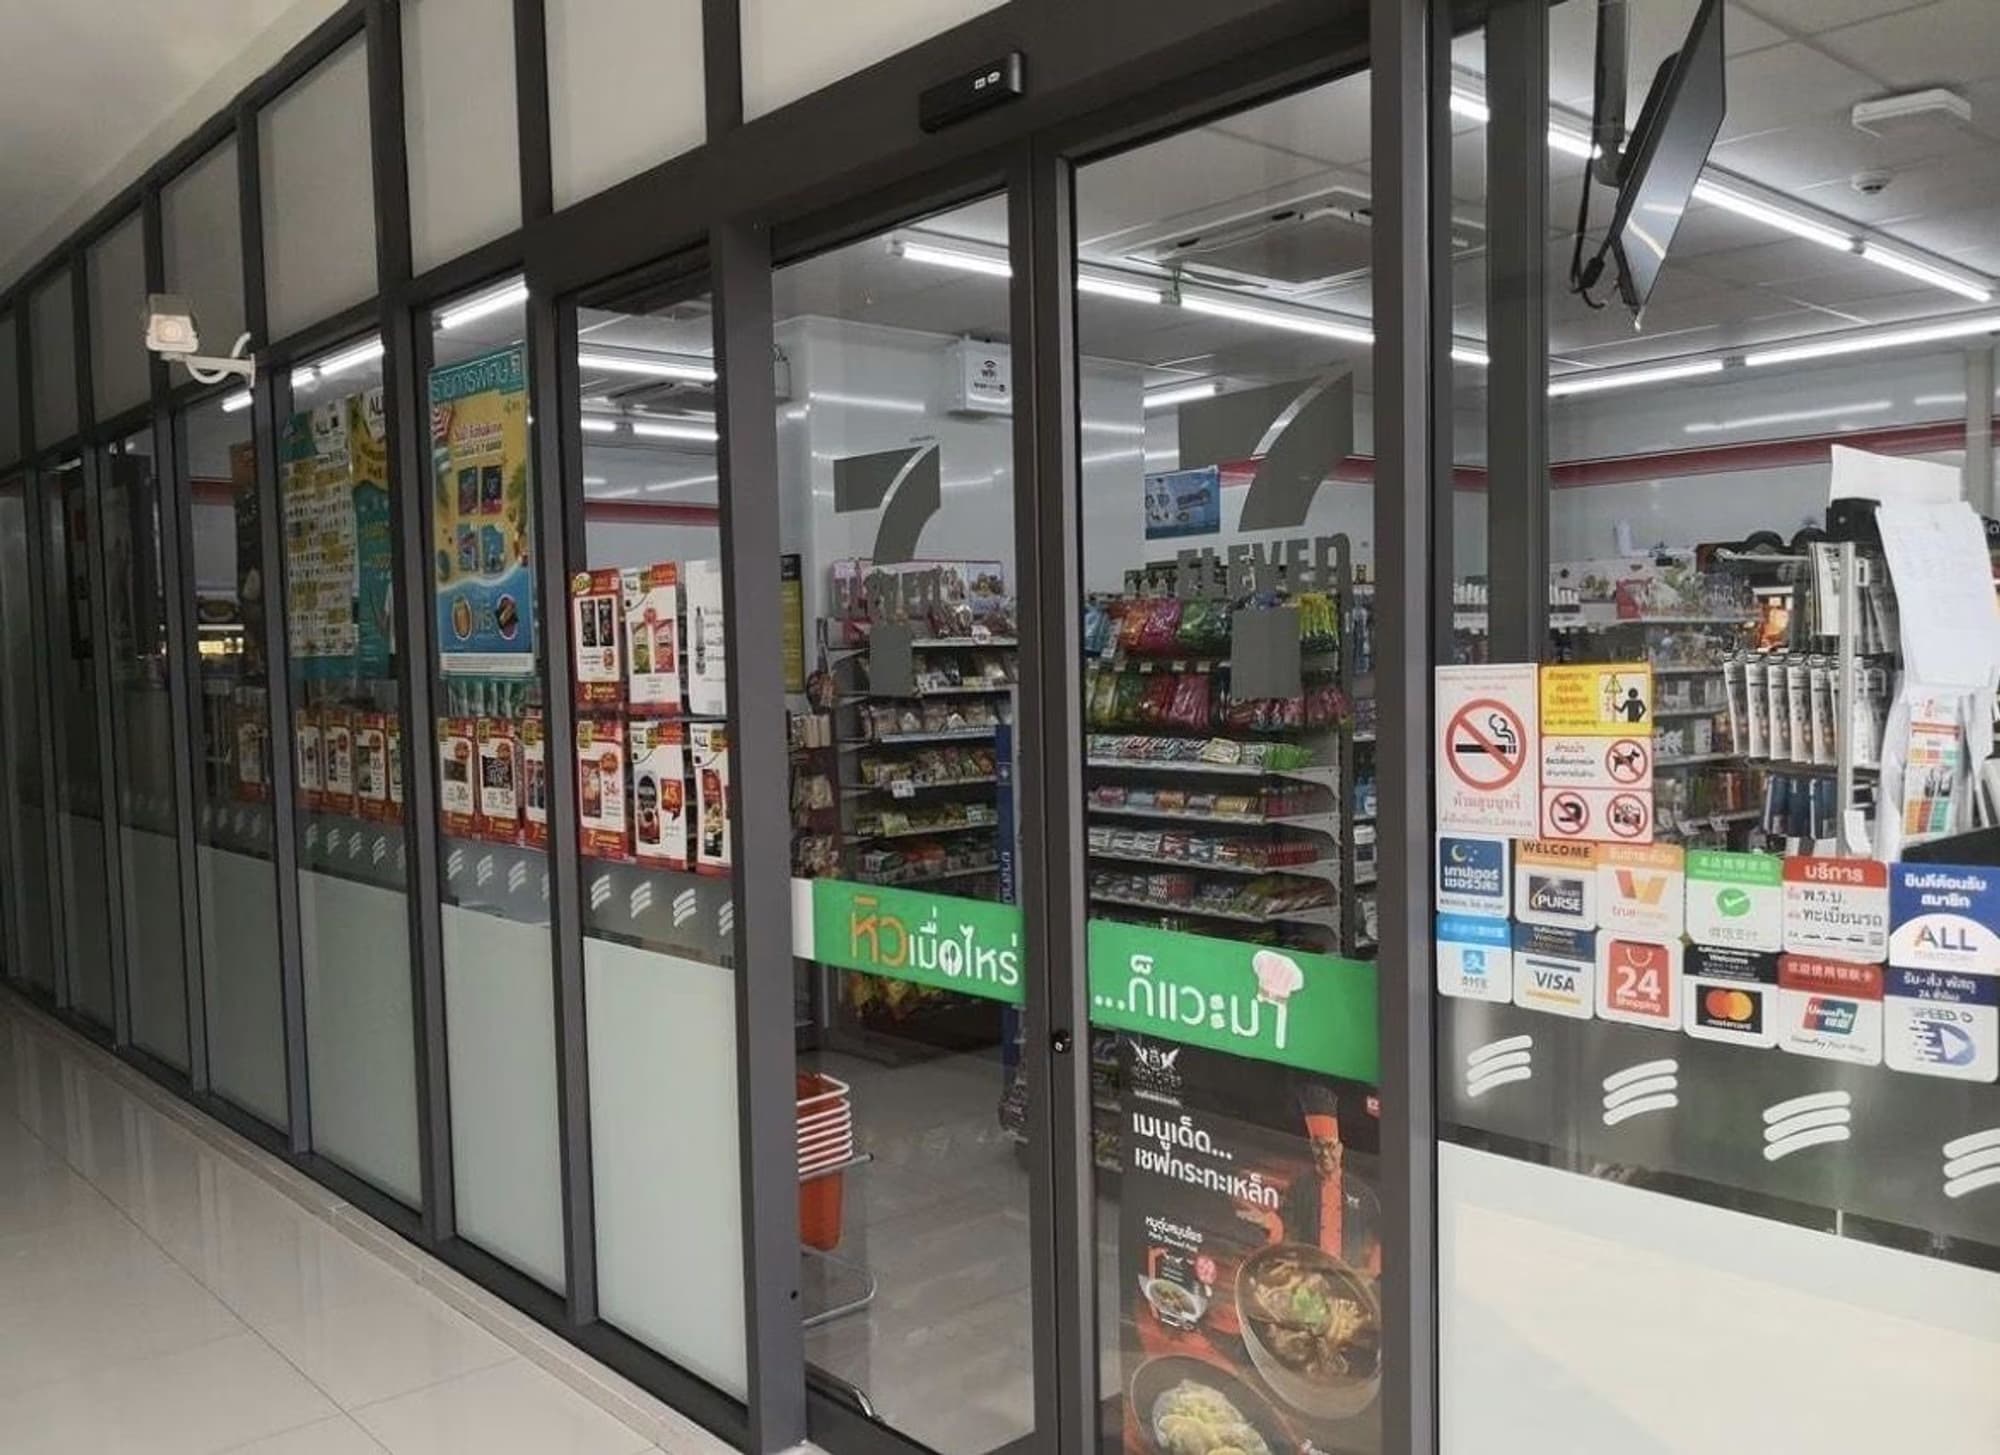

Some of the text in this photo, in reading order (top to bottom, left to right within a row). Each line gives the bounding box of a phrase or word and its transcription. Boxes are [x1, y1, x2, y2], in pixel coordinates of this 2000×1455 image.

[1522, 842, 1591, 858] WELCOME
[1804, 861, 1865, 883] บริการ
[1537, 894, 1583, 912] PURSE
[1803, 906, 1883, 927] ทะเบียนรถ
[851, 896, 1019, 986] หิวเมื่อไหร่
[1914, 924, 1978, 952] ALL
[1534, 970, 1576, 993] VISA
[1615, 965, 1662, 1002] 24
[1132, 1112, 1233, 1160] เมนูเด็ด...
[1134, 1147, 1279, 1209] เชฟกระทะเหล็ก
